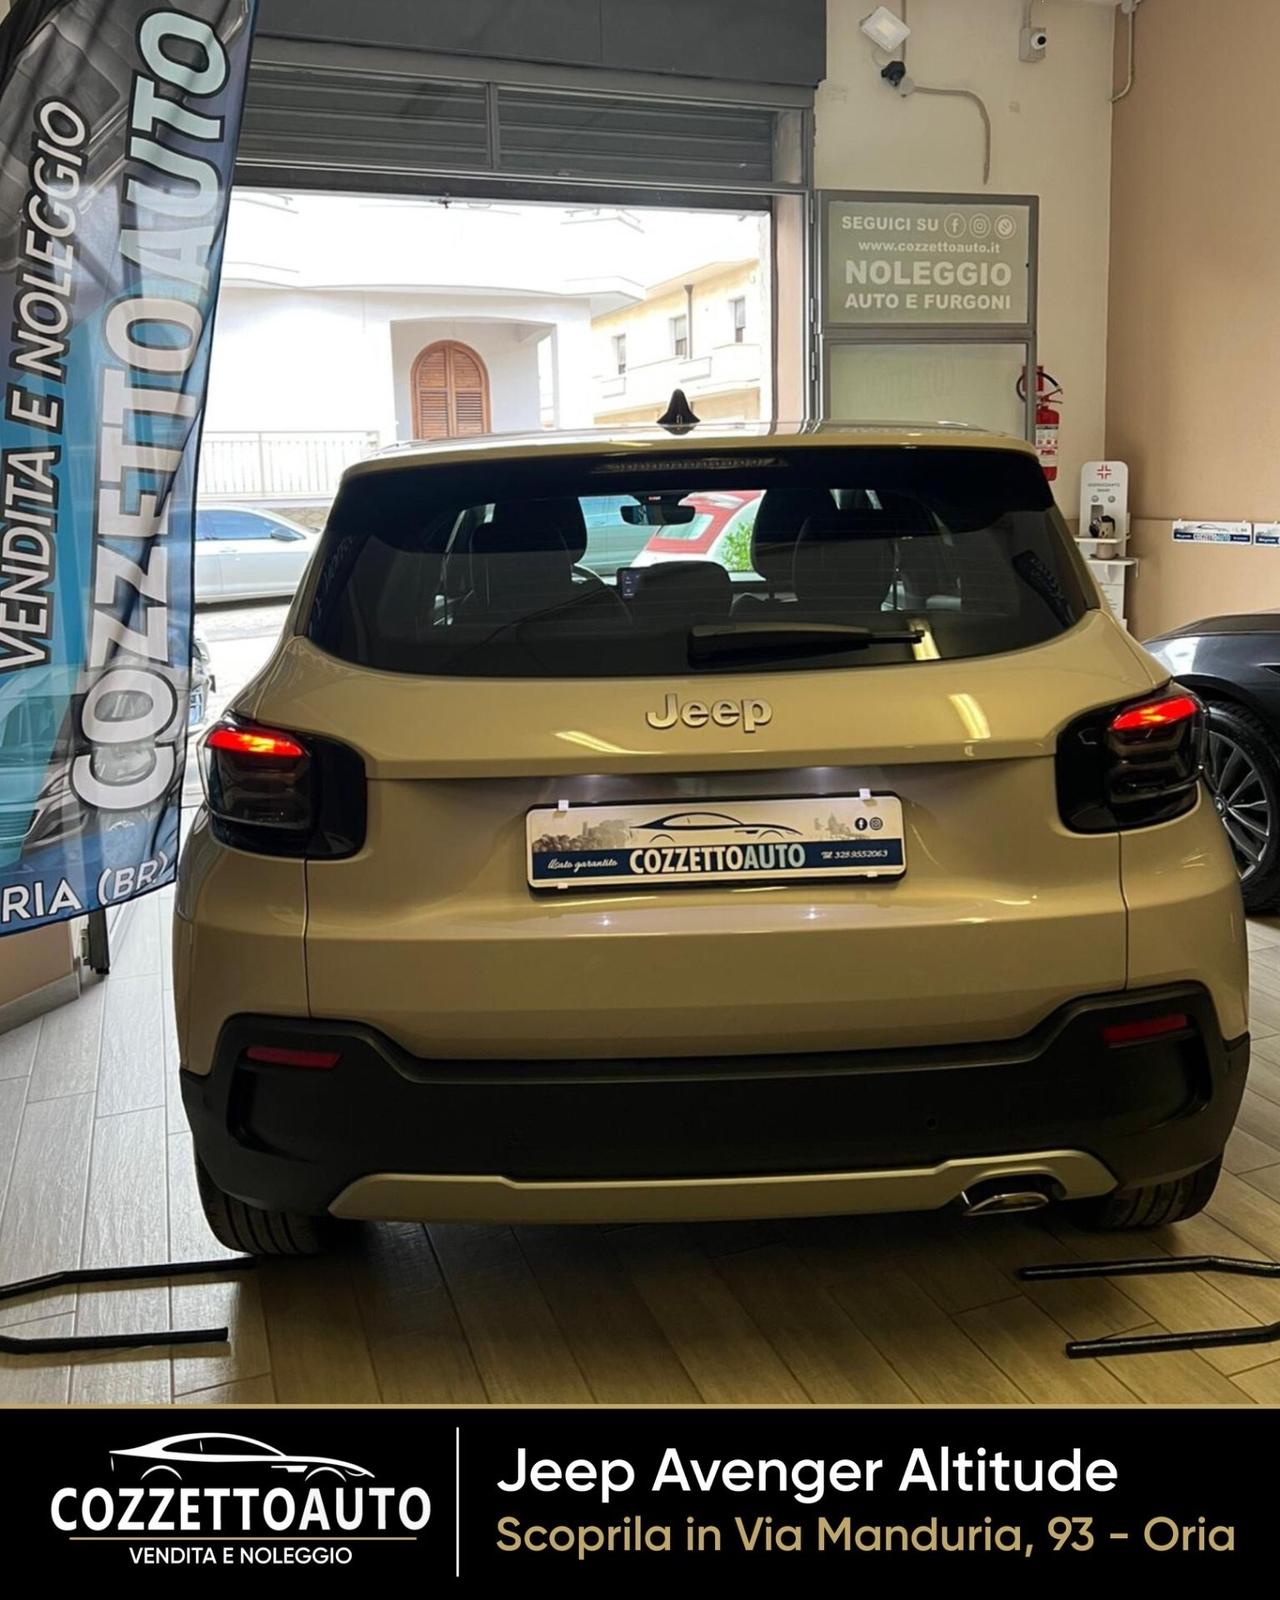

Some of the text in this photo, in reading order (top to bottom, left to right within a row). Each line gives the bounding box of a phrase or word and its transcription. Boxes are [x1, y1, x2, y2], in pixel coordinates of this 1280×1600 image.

[841, 215, 939, 231] SEGUICI SU
[858, 241, 1001, 254] www.cozzettoauto.it
[845, 260, 1012, 286] NOLEGGIO
[844, 293, 1011, 310] AUTO E FURGONI
[0, 101, 86, 669] VENDITA E NOLEGGIO
[72, 11, 229, 810] COZZETTOAUTO
[646, 693, 773, 733] Jeep
[573, 858, 618, 873] garantito
[628, 843, 806, 875] COZZETTOAUTO
[1, 878, 83, 922] RIA
